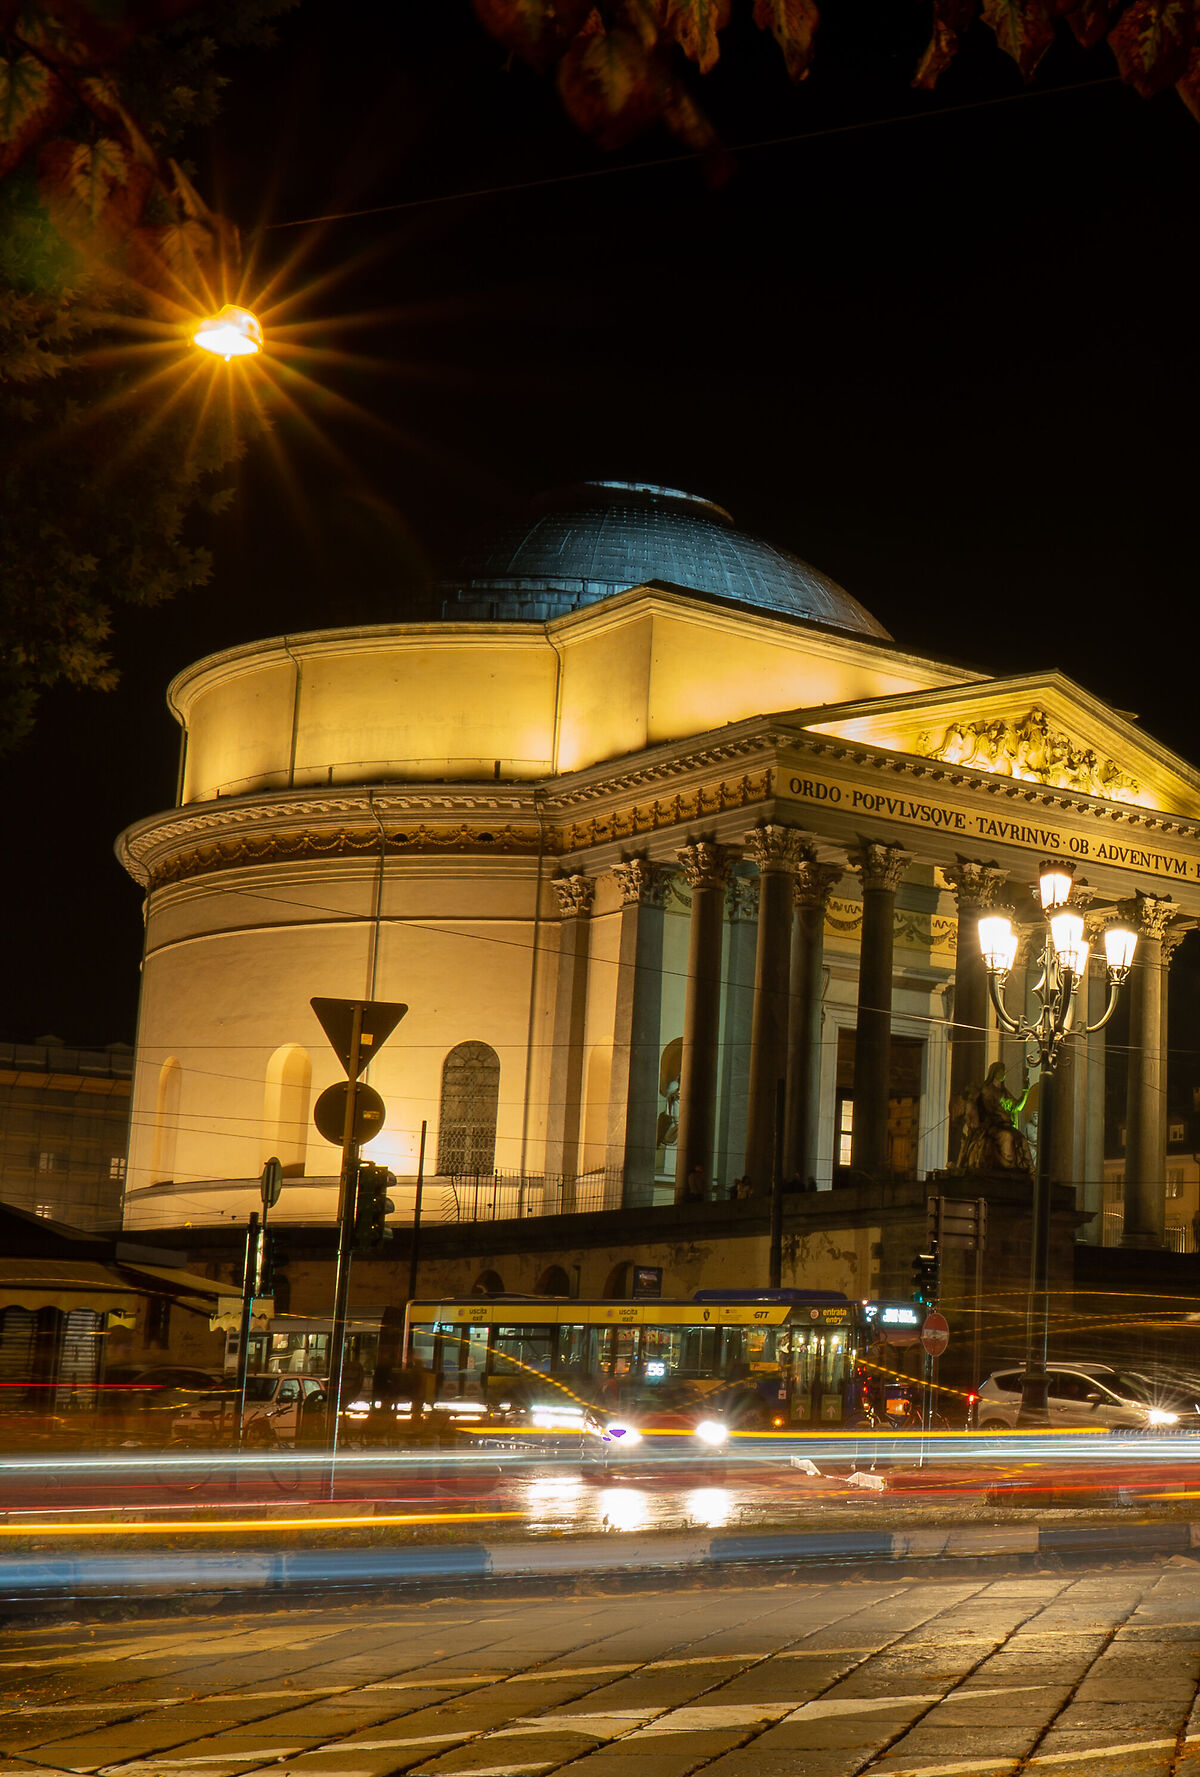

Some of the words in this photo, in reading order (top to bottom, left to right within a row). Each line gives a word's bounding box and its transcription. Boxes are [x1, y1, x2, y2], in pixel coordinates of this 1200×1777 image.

[789, 777, 842, 803] ORDO
[852, 790, 967, 830] POPVLVSQVE
[975, 816, 1061, 849] TAVRINVS
[1069, 837, 1089, 855] OB
[1096, 843, 1188, 876] ADVENTVM
[753, 1311, 770, 1319] GTT
[822, 1308, 848, 1316] entrata
[825, 1316, 844, 1325] entry
